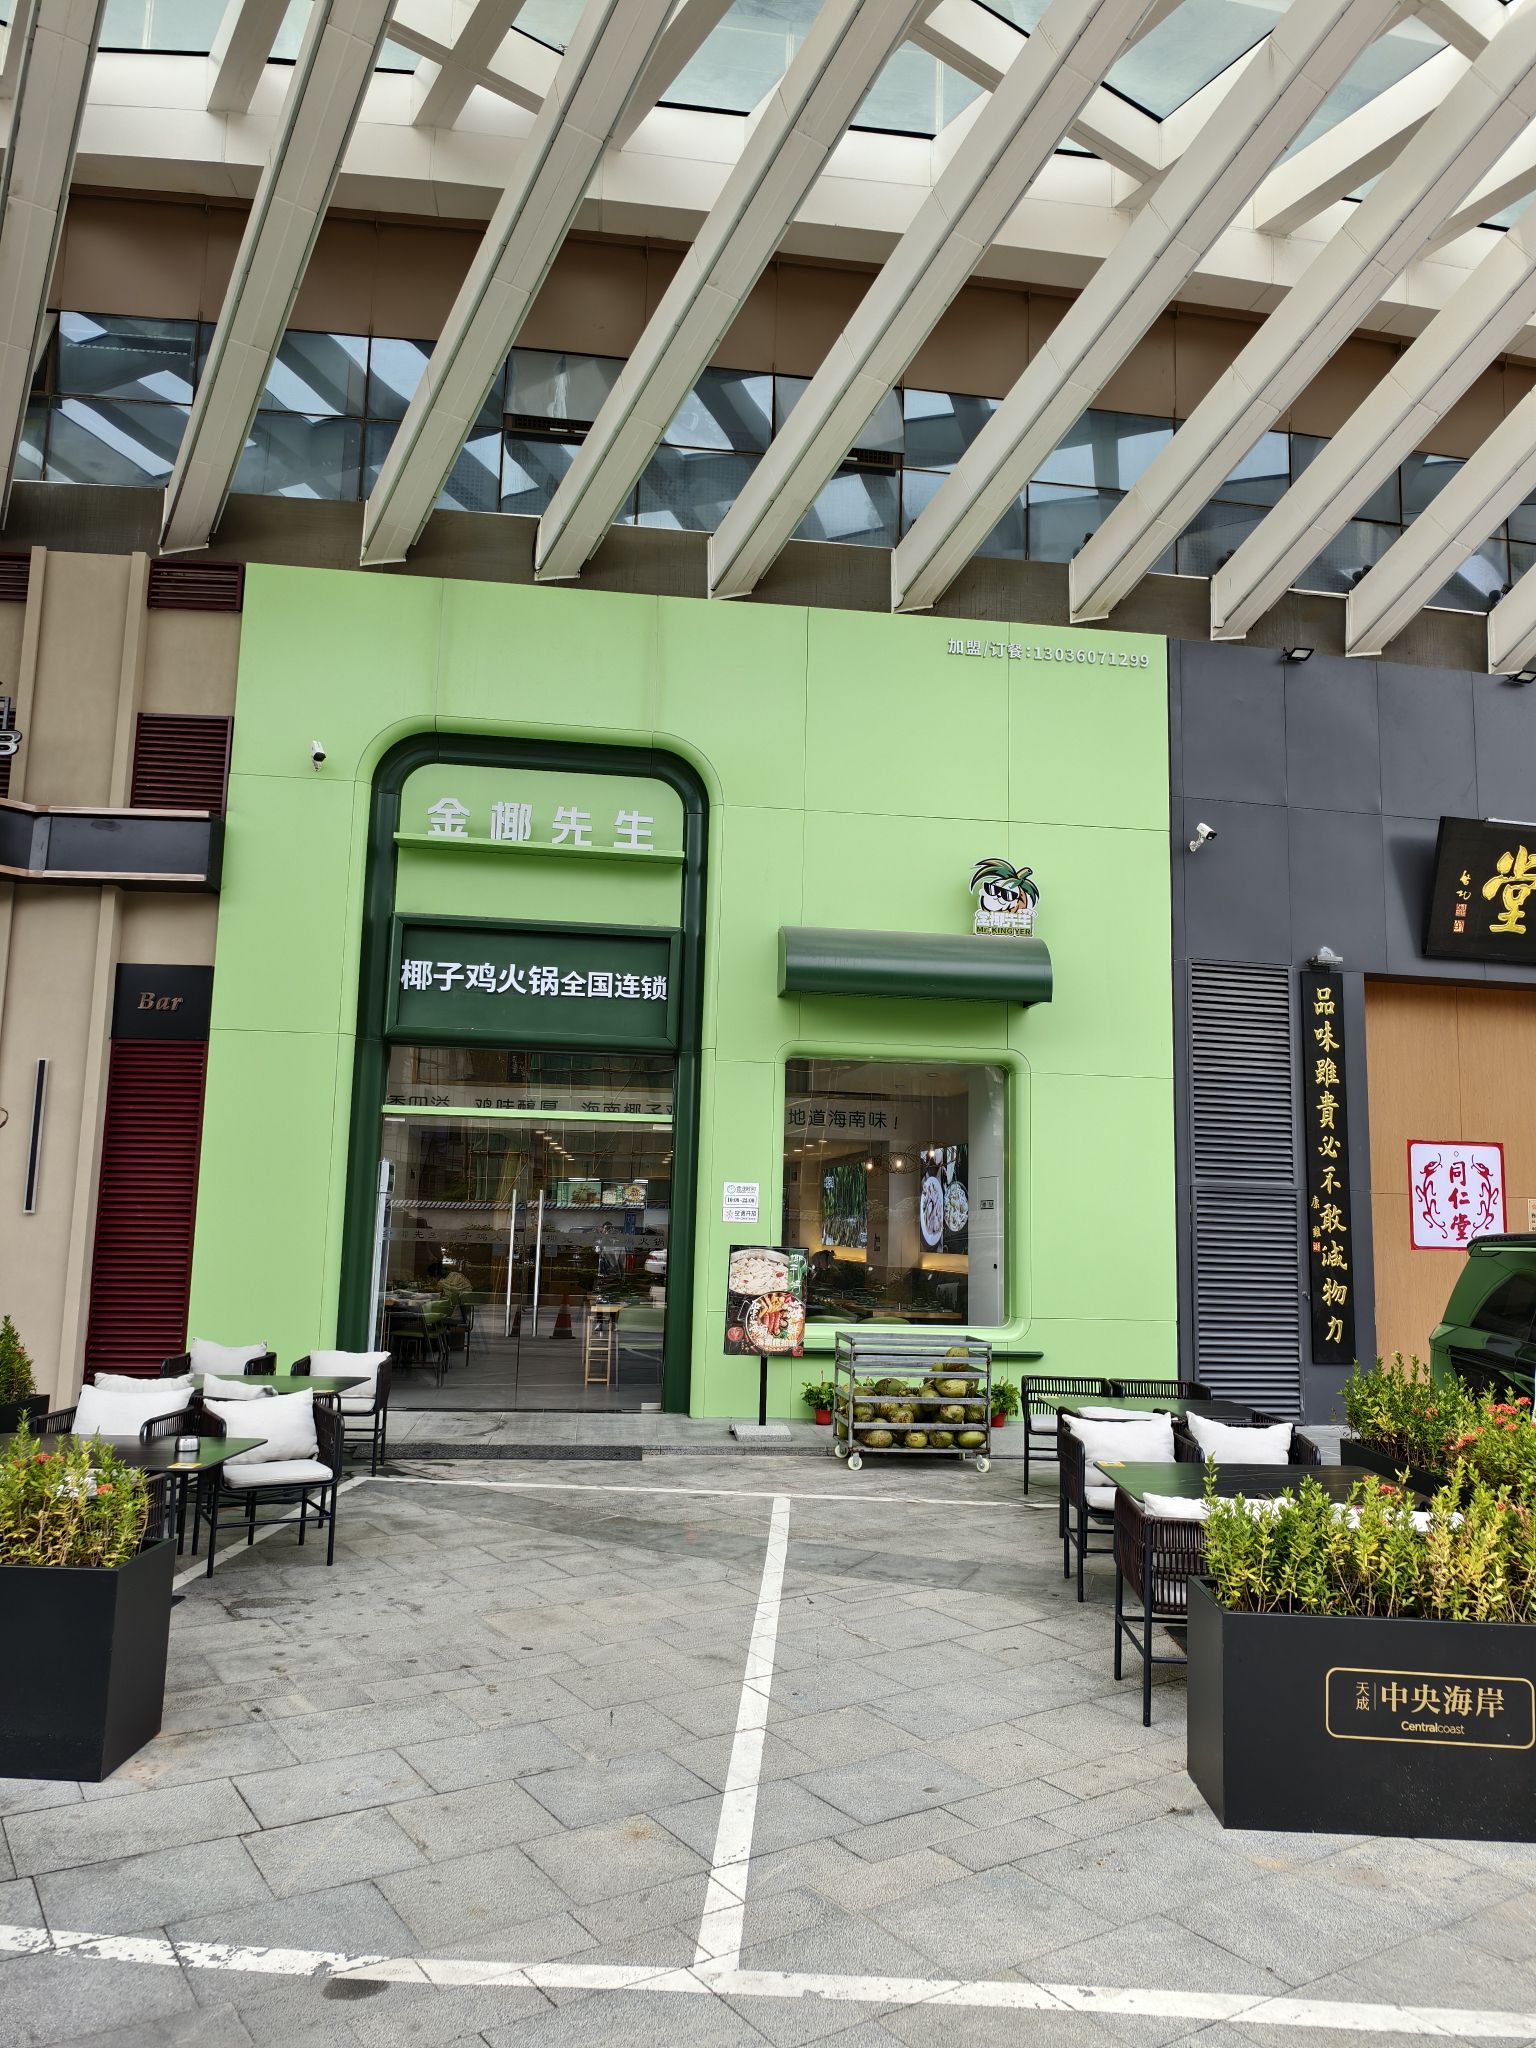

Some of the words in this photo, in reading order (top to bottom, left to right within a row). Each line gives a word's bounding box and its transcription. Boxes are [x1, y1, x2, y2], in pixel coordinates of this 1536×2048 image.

[947, 638, 1150, 668] 加盟/订餐:13036071299
[427, 797, 655, 851] 金椰先生
[1482, 844, 1536, 935] 堂
[400, 959, 668, 1001] 椰子鸡火锅全国连锁
[137, 991, 184, 1011] Bar
[1448, 1161, 1472, 1241] 同仁堂
[1355, 1681, 1370, 1711] 天成
[1381, 1681, 1504, 1719] 中央海岸
[1400, 1720, 1465, 1735] Centralcoast
